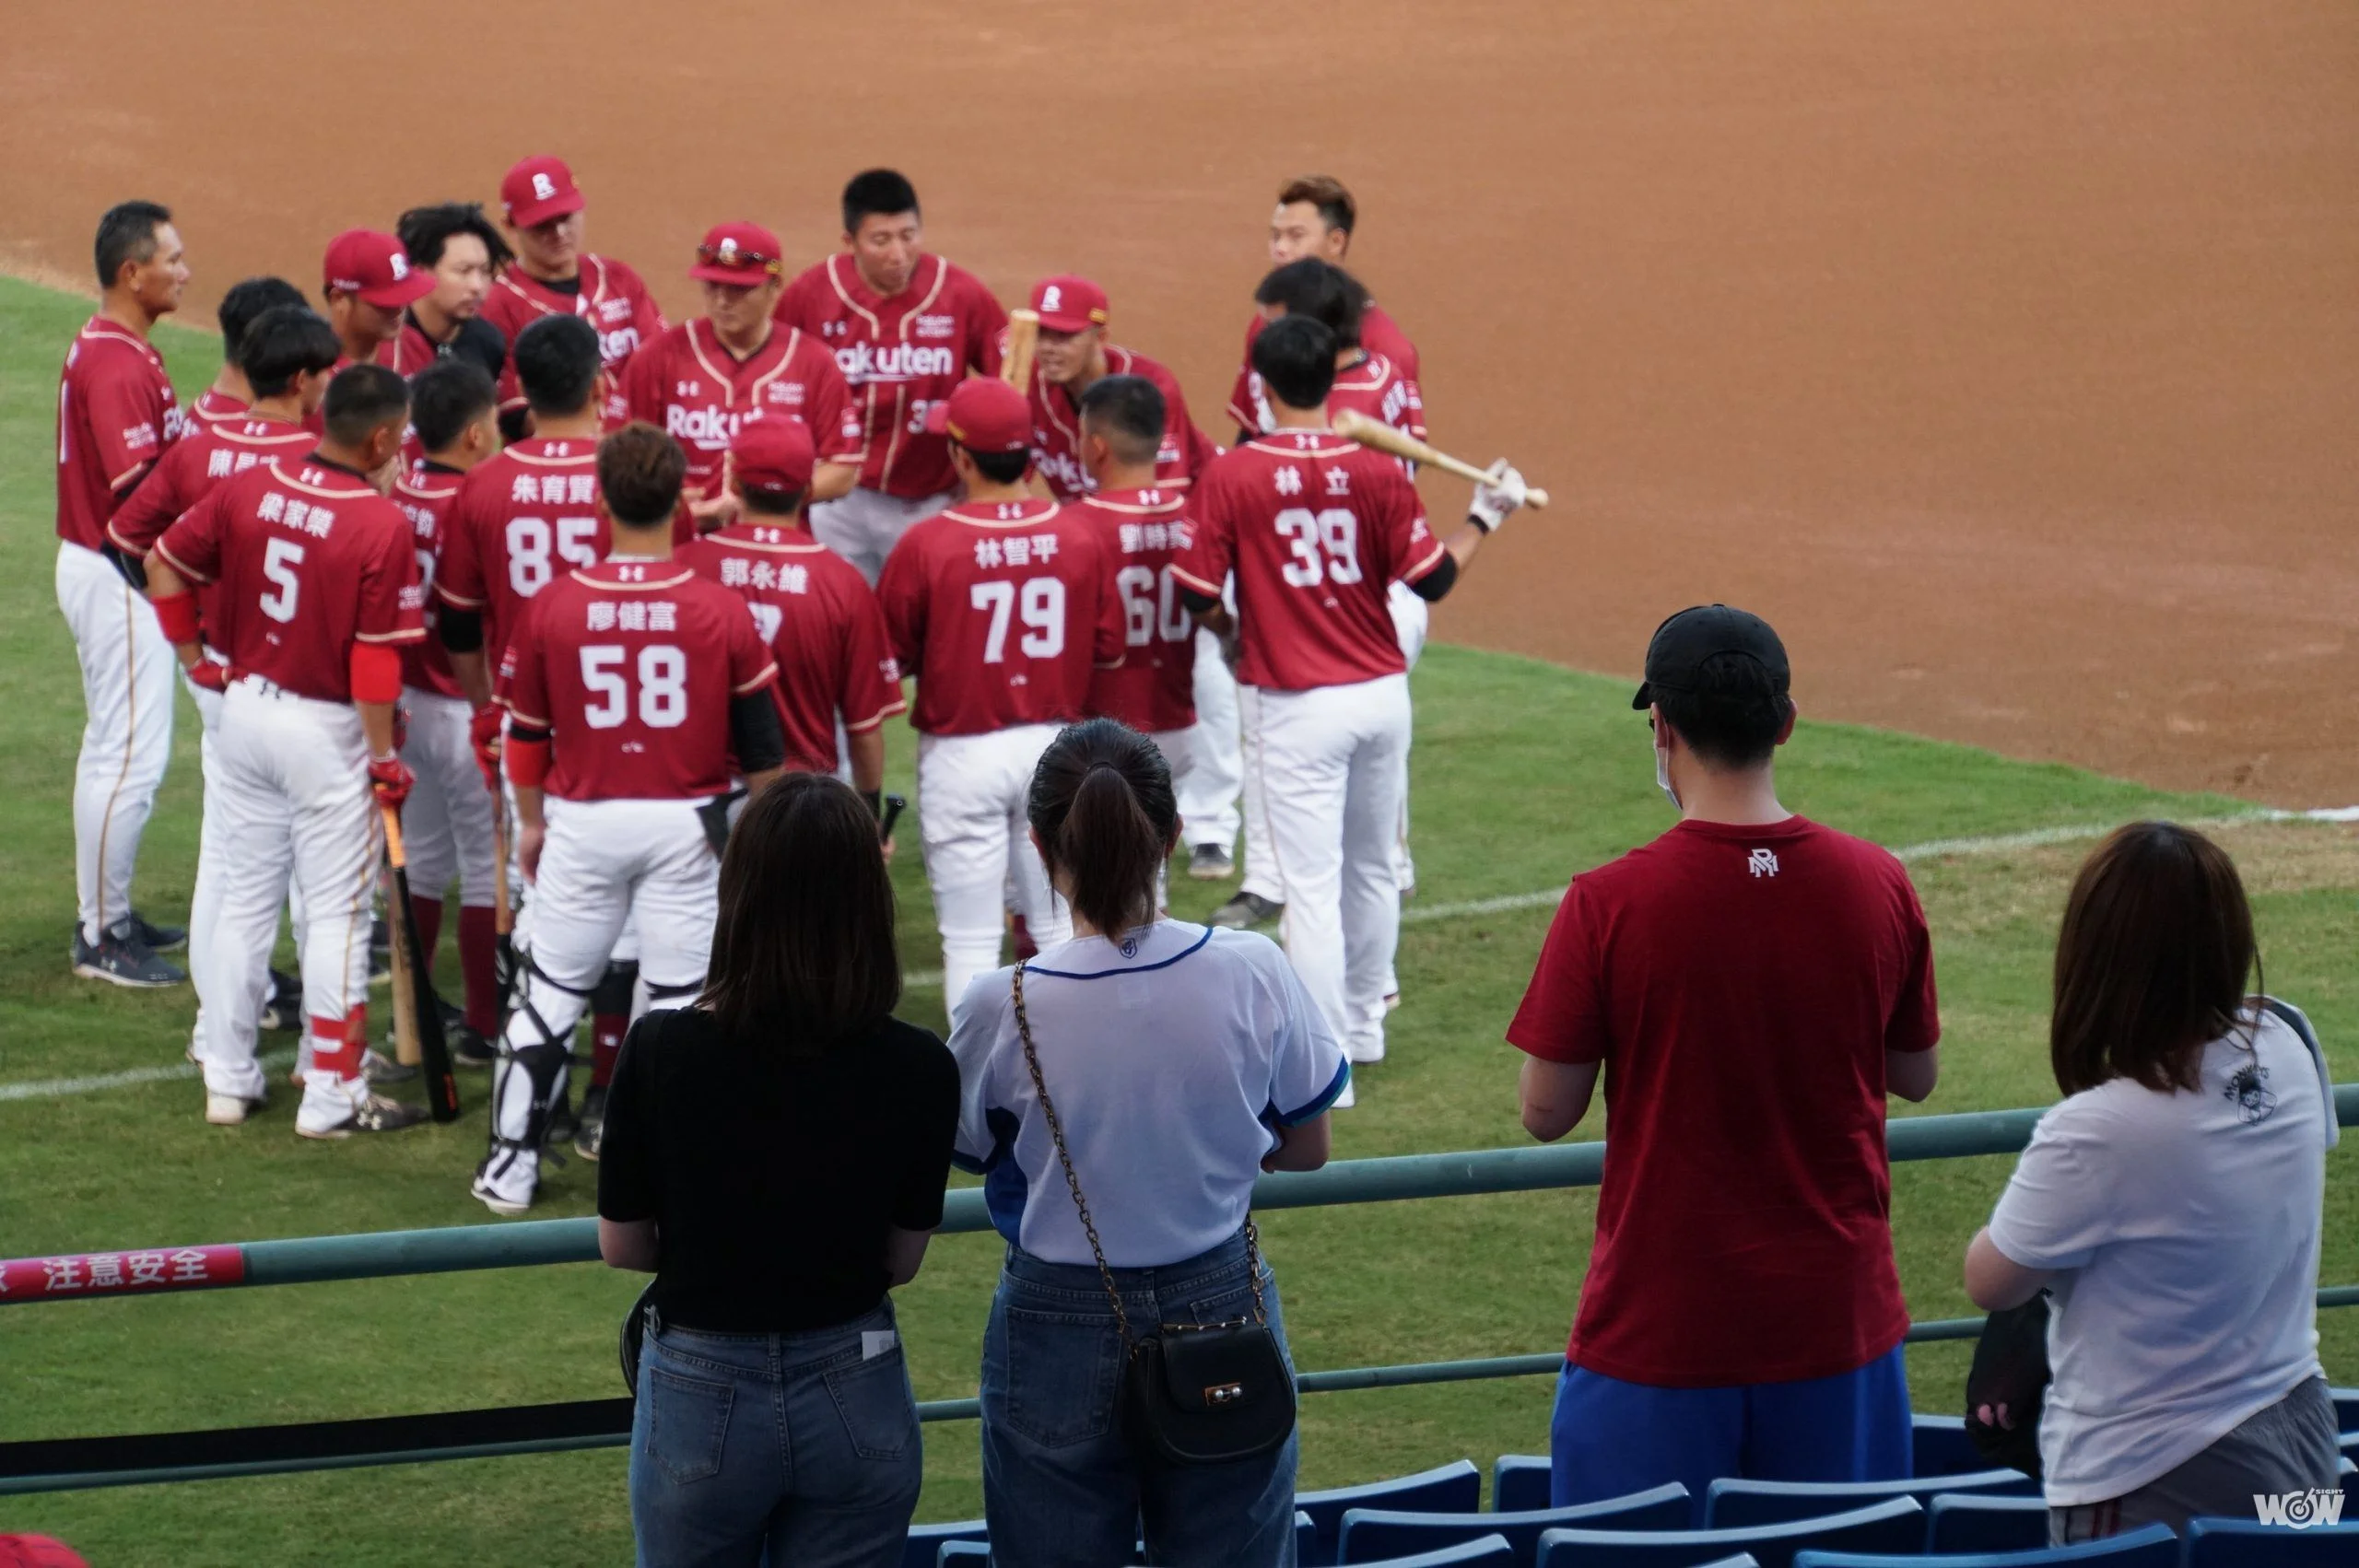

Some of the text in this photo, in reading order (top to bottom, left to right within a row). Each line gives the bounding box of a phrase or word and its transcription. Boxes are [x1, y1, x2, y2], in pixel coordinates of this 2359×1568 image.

[834, 340, 954, 379] akuten
[511, 474, 596, 505] 朱育賢
[260, 536, 305, 625] 5
[506, 516, 598, 599] 85
[974, 532, 1059, 569] 林智平
[1274, 508, 1363, 588] 39
[586, 601, 678, 632] 廖健富
[970, 576, 1066, 663] 79
[1115, 565, 1191, 647] 60
[579, 645, 688, 730] 58
[42, 1248, 209, 1292] 注意安全
